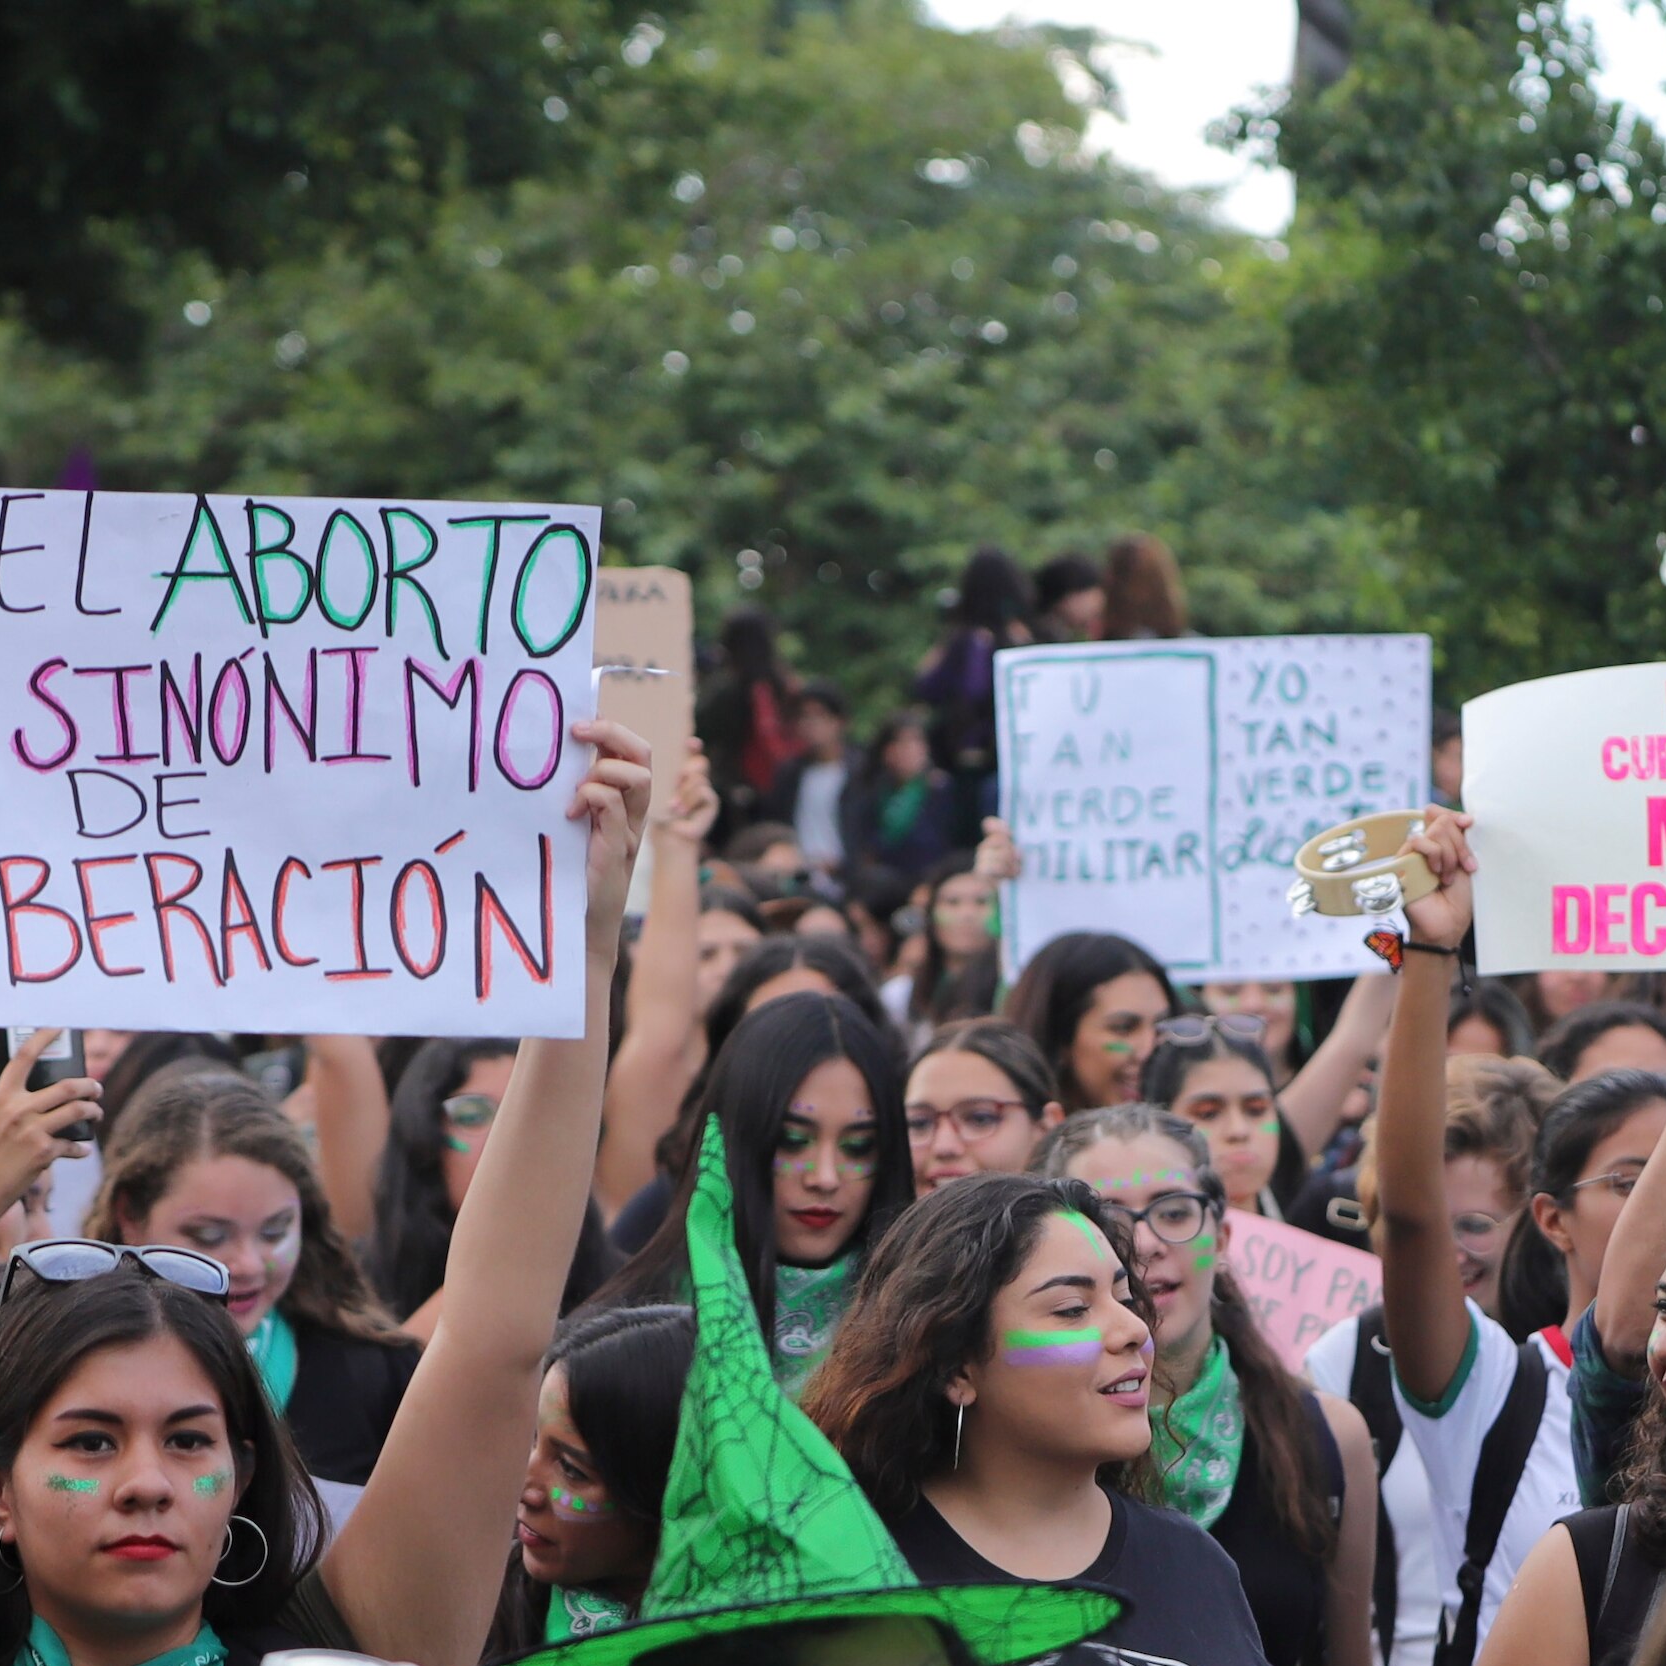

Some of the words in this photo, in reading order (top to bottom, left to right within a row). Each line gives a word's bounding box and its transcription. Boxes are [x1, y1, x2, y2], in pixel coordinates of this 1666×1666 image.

[148, 493, 592, 662] ABORTO
[1246, 658, 1310, 706] YO
[8, 645, 567, 794] SINÓNIMO
[1238, 710, 1338, 757] TAN
[66, 767, 211, 841] DE
[1236, 760, 1388, 809] VERDE
